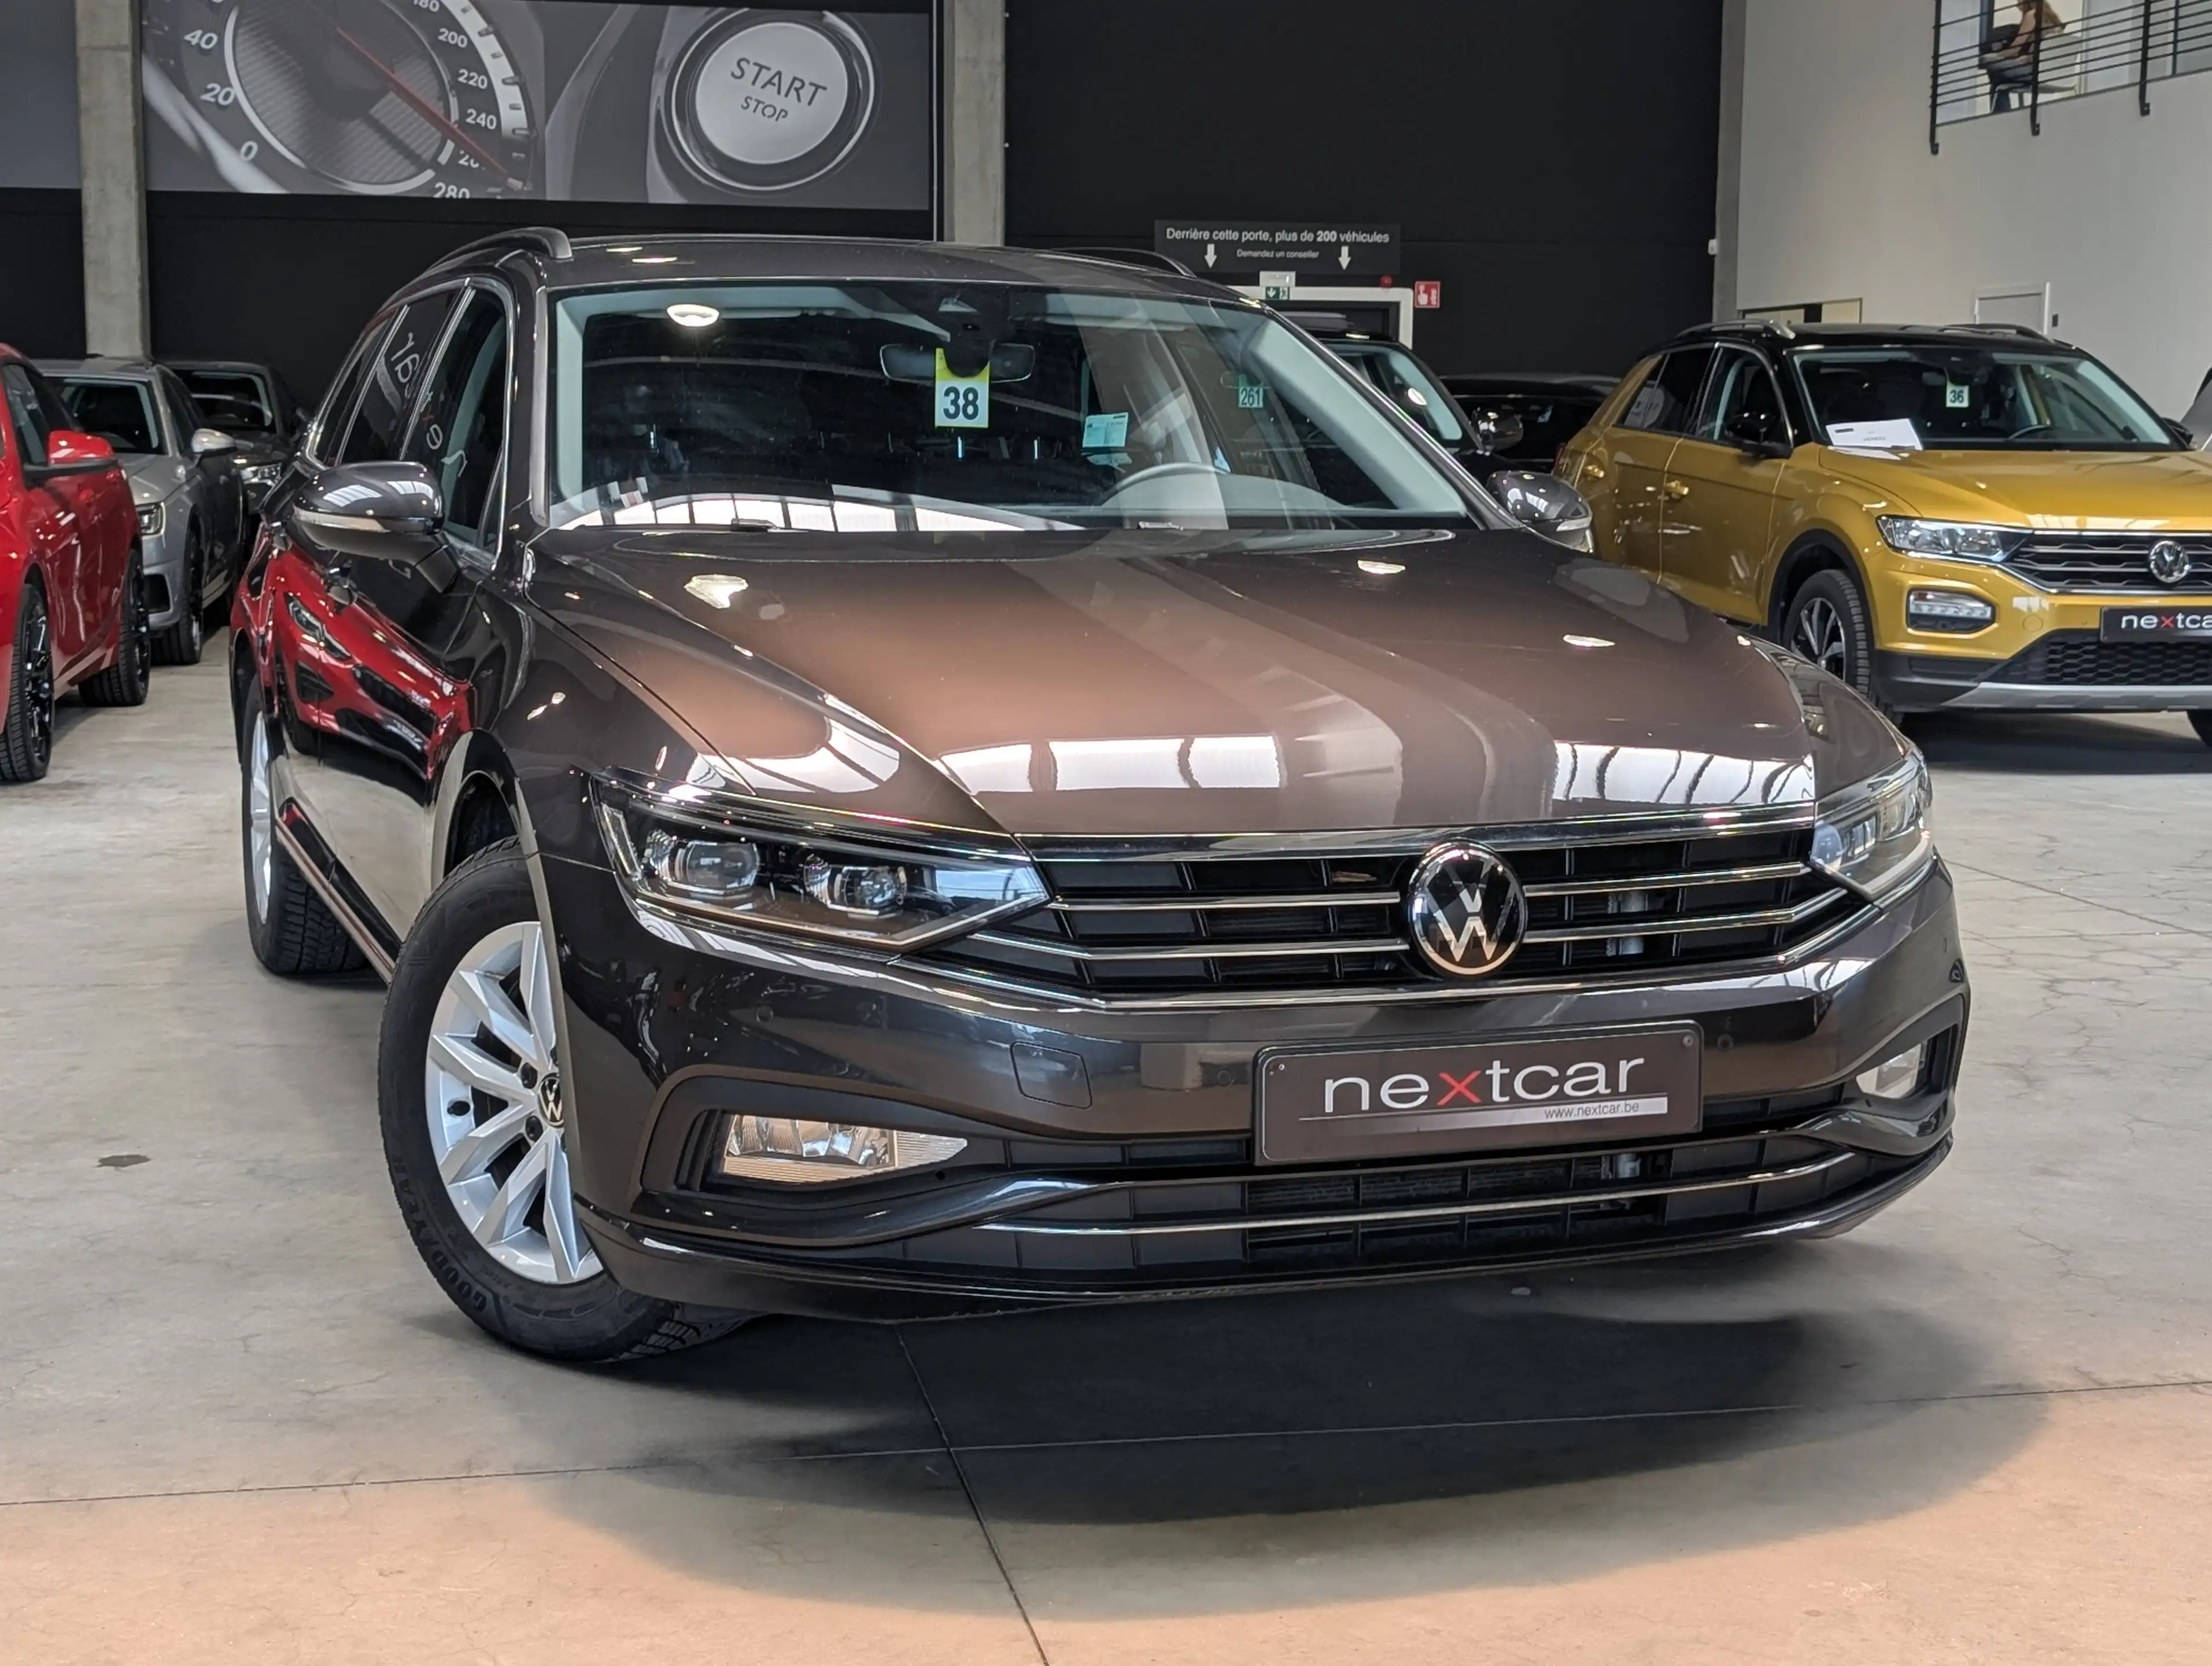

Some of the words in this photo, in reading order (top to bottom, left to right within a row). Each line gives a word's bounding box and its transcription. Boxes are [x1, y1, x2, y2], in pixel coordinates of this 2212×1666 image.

[183, 29, 218, 50] 40
[438, 28, 468, 48] 200
[457, 69, 488, 90] 220
[730, 57, 828, 106] START
[200, 83, 235, 105] 20
[466, 108, 497, 130] 240
[741, 95, 788, 122] STOP
[241, 141, 258, 162] 0
[1166, 227, 1210, 240] Derrière
[1212, 229, 1239, 241] cette
[1275, 230, 1298, 244] plus
[1300, 230, 1314, 242] de
[1316, 230, 1338, 242] 200
[1339, 230, 1390, 243] véhicules
[943, 386, 980, 420] 38
[1240, 388, 1260, 406] 261
[1949, 389, 1964, 403] 36
[1324, 1057, 1645, 1113] nextcar
[1545, 1100, 1639, 1119] www.nextcar.be
